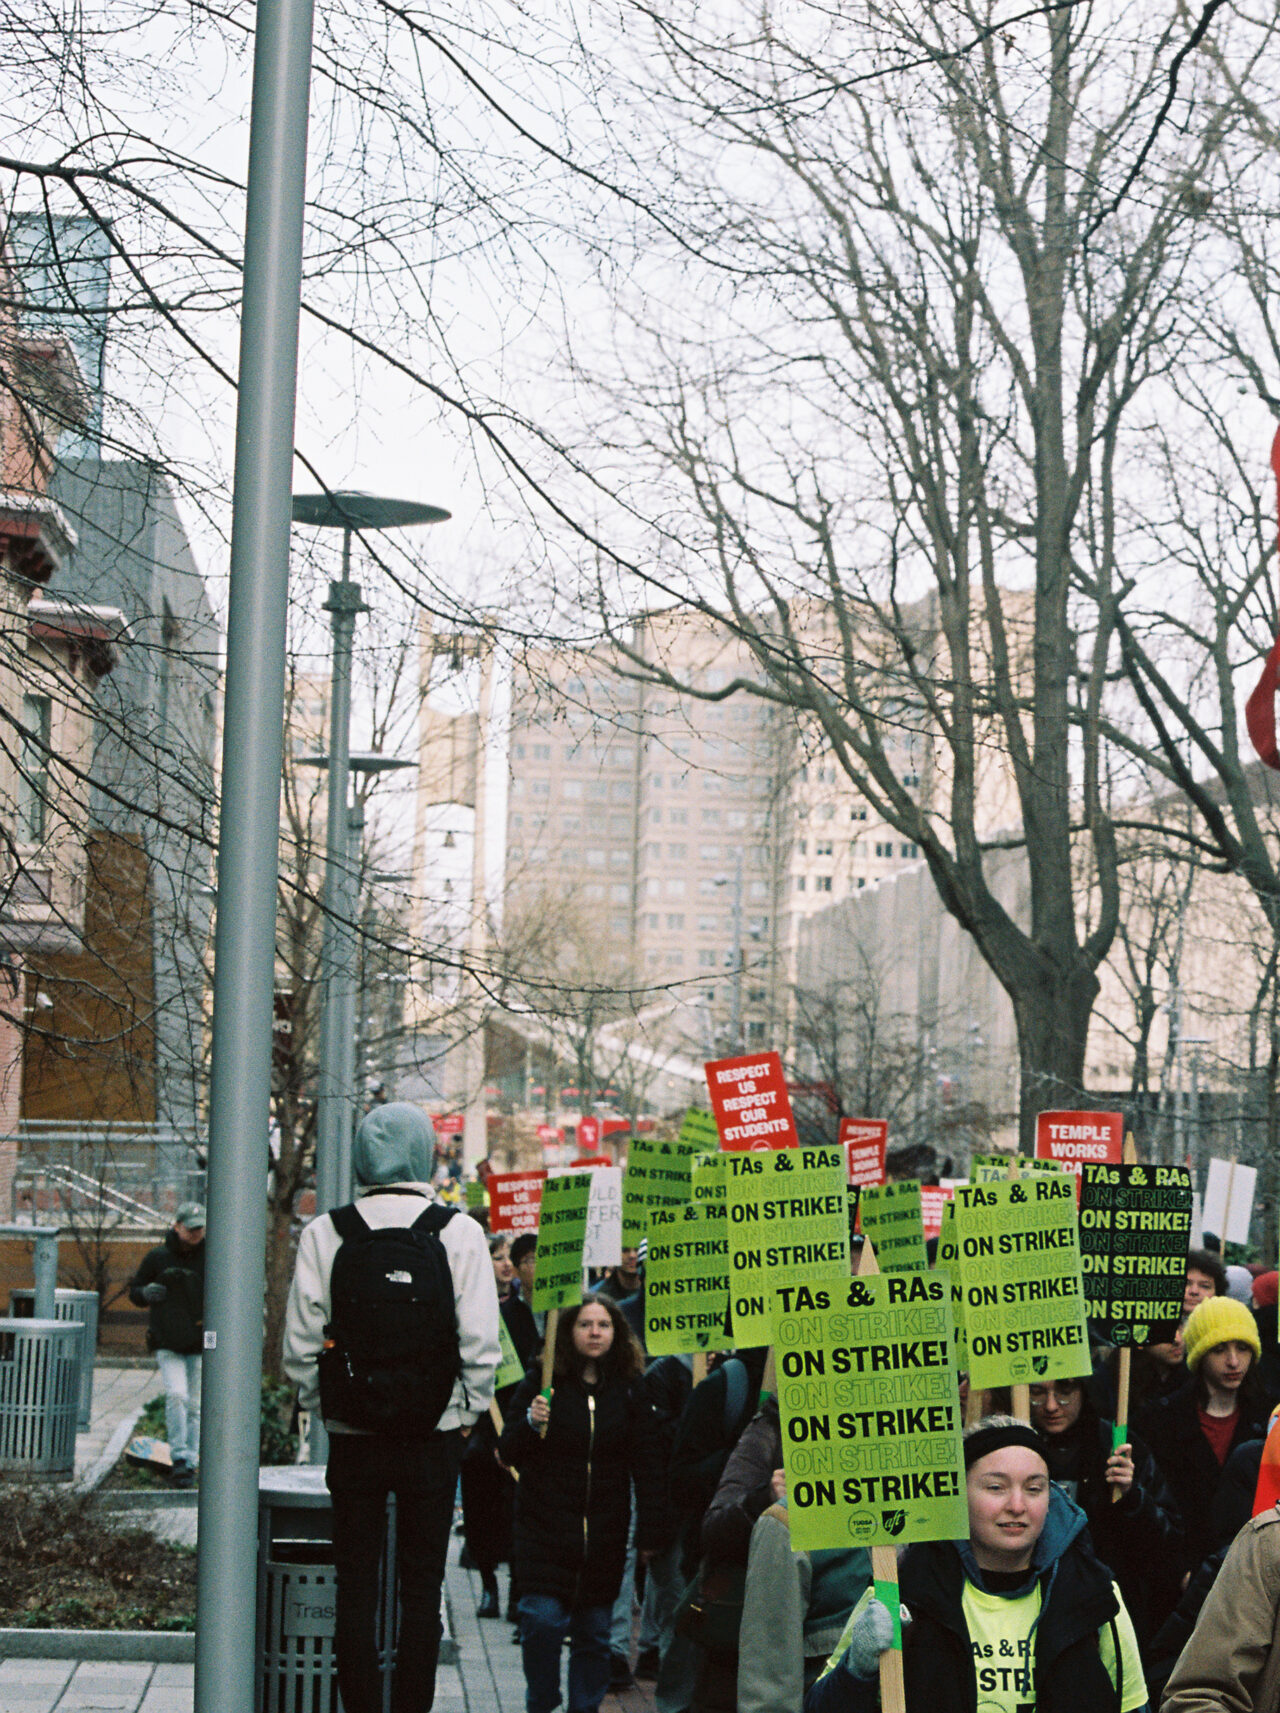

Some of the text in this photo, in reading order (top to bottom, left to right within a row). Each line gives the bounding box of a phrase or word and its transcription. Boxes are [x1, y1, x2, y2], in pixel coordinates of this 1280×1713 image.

[716, 1063, 770, 1083] RESPECT
[738, 1081, 756, 1094] US
[723, 1092, 776, 1112] RESPECT
[740, 1109, 767, 1123] OUR
[724, 1118, 789, 1141] STUDENTS
[1049, 1125, 1111, 1141] TEMPLE
[633, 1141, 653, 1152] TAs
[1050, 1143, 1107, 1158] WORKS
[629, 1167, 646, 1177] ON
[730, 1157, 763, 1176] TAs
[774, 1153, 793, 1172] &
[803, 1151, 840, 1169] RAs
[1085, 1165, 1120, 1185] TAs
[1128, 1167, 1148, 1185] &
[1156, 1168, 1190, 1186] RAs
[959, 1188, 998, 1208] TAs
[1009, 1184, 1027, 1203] &
[1036, 1181, 1071, 1200] RAs
[651, 1211, 675, 1225] TAs
[684, 1207, 698, 1220] &
[731, 1196, 842, 1222] ON STRIKE!
[541, 1213, 553, 1226] ON
[1081, 1210, 1189, 1231] ON STRIKE!
[539, 1245, 550, 1258] ON
[963, 1228, 1074, 1257] ON STRIKE!
[650, 1246, 670, 1261] ON
[734, 1242, 845, 1270] ON STRIKE!
[1081, 1255, 1186, 1275] ON STRIKE!
[649, 1276, 730, 1296] ON STRIKE
[776, 1276, 943, 1313] TAs & RAs
[968, 1277, 1078, 1307] ON STRIKE!
[1111, 1301, 1181, 1320] STRIKE!
[649, 1312, 726, 1332] ON STRIK
[779, 1307, 947, 1346] ON STRIKE!
[972, 1335, 1001, 1356] ON
[1006, 1325, 1082, 1352] STRIKE!
[782, 1341, 949, 1377] ON STRIKE!
[788, 1406, 954, 1442] ON STRIKE!
[794, 1472, 959, 1507] ON STRIKE!
[293, 1602, 334, 1619] Tras
[999, 1639, 1014, 1657] &
